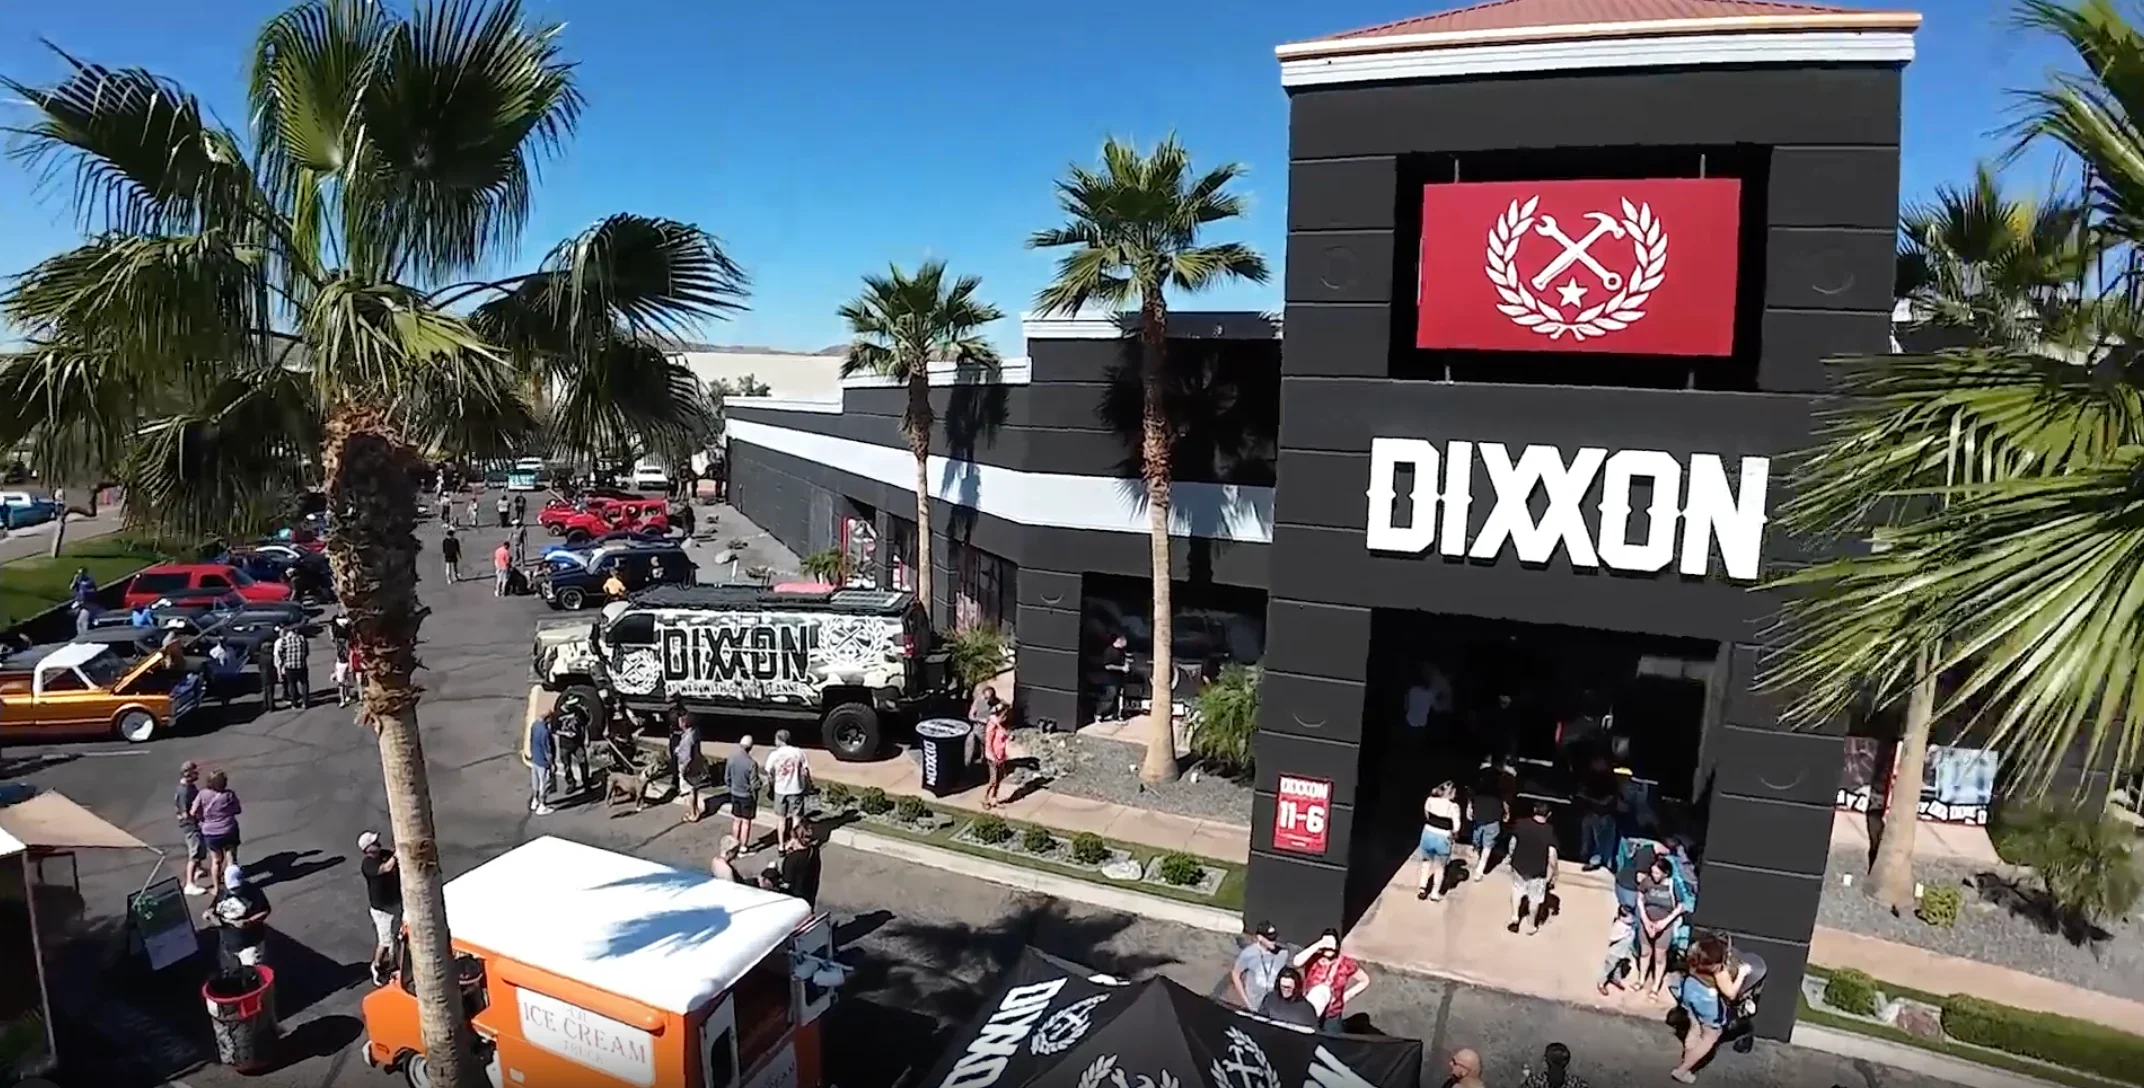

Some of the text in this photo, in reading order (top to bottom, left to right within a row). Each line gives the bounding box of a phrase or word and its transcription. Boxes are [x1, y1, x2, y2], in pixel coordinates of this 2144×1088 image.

[1366, 436, 1771, 580] DIXXON
[662, 626, 809, 682] DIXXON
[923, 739, 937, 786] DIXXON
[1279, 801, 1326, 834] 11-6
[524, 1001, 646, 1065] ICE CREAM
